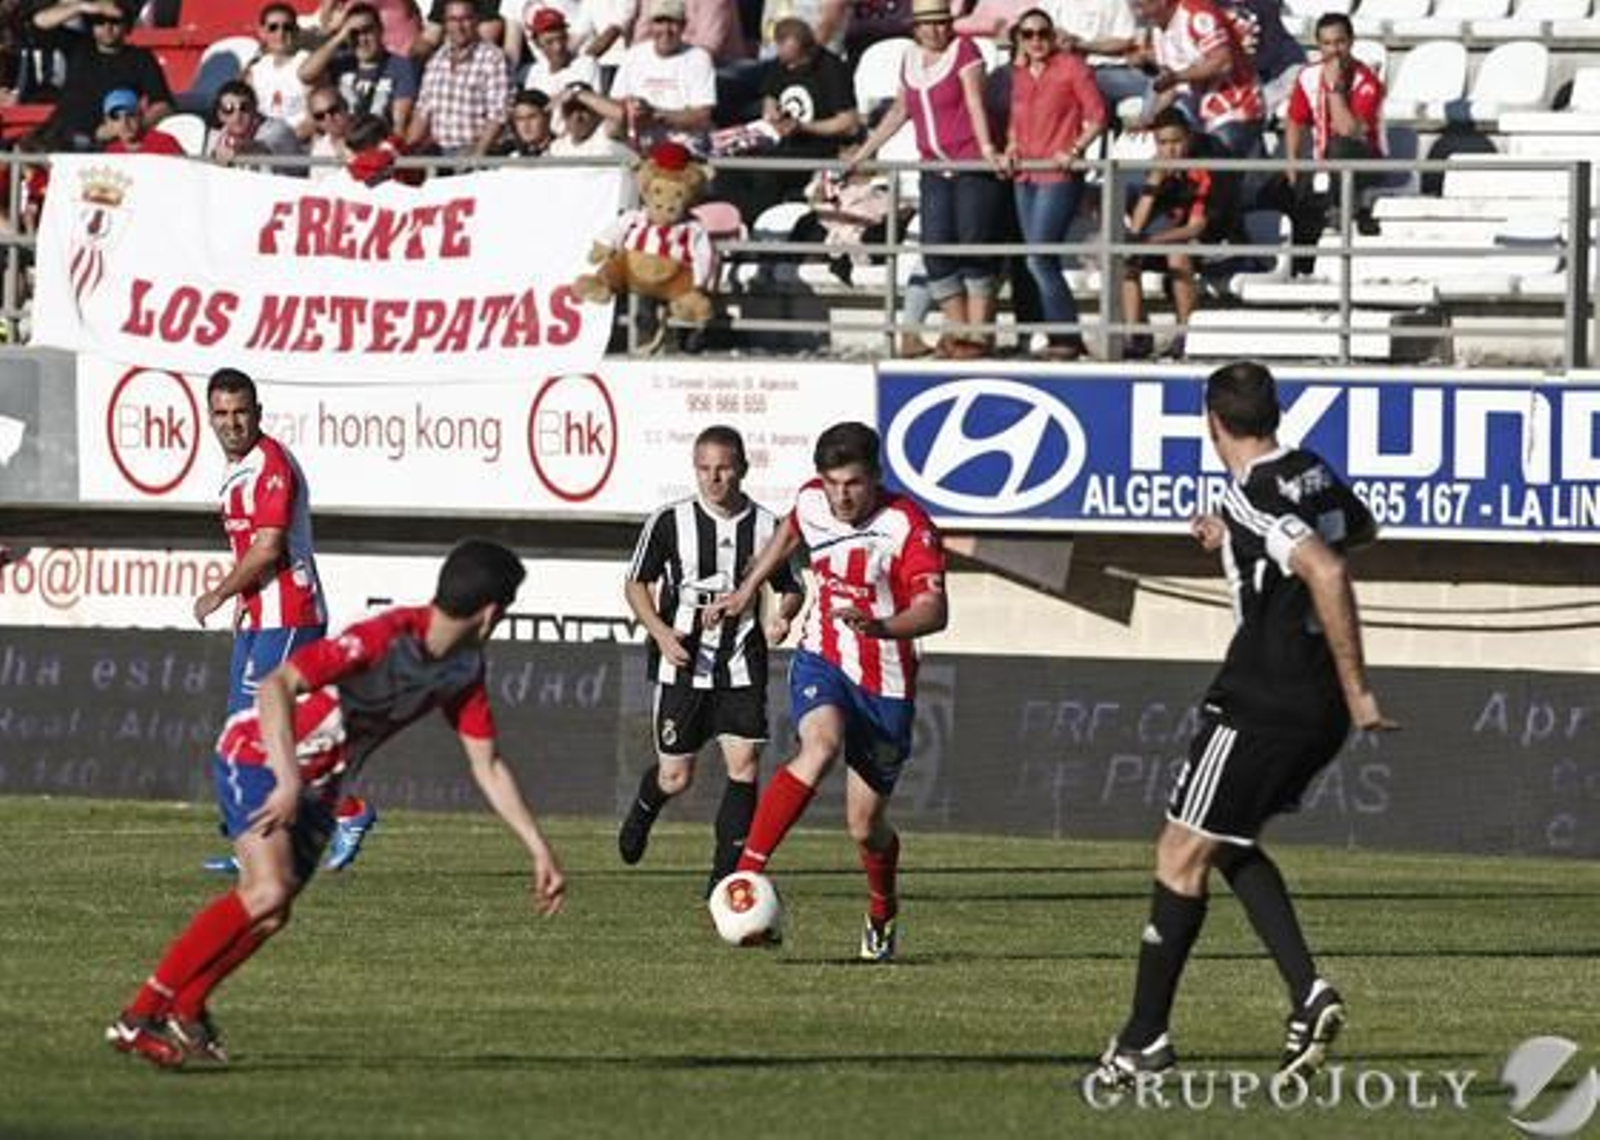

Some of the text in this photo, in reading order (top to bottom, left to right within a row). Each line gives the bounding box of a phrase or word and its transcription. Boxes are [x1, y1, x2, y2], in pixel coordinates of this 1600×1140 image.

[258, 195, 477, 260] FRENTE
[121, 280, 584, 353] LOS METEPATAS
[119, 405, 187, 450] Bhk
[318, 401, 406, 460] hong
[415, 403, 502, 462] kong
[539, 410, 606, 456] Bhk
[1081, 473, 1229, 517] ALGECIR
[1415, 482, 1471, 525] 167
[1479, 503, 1492, 516] -
[1501, 483, 1545, 527] LA
[0, 546, 226, 610] o@lumine
